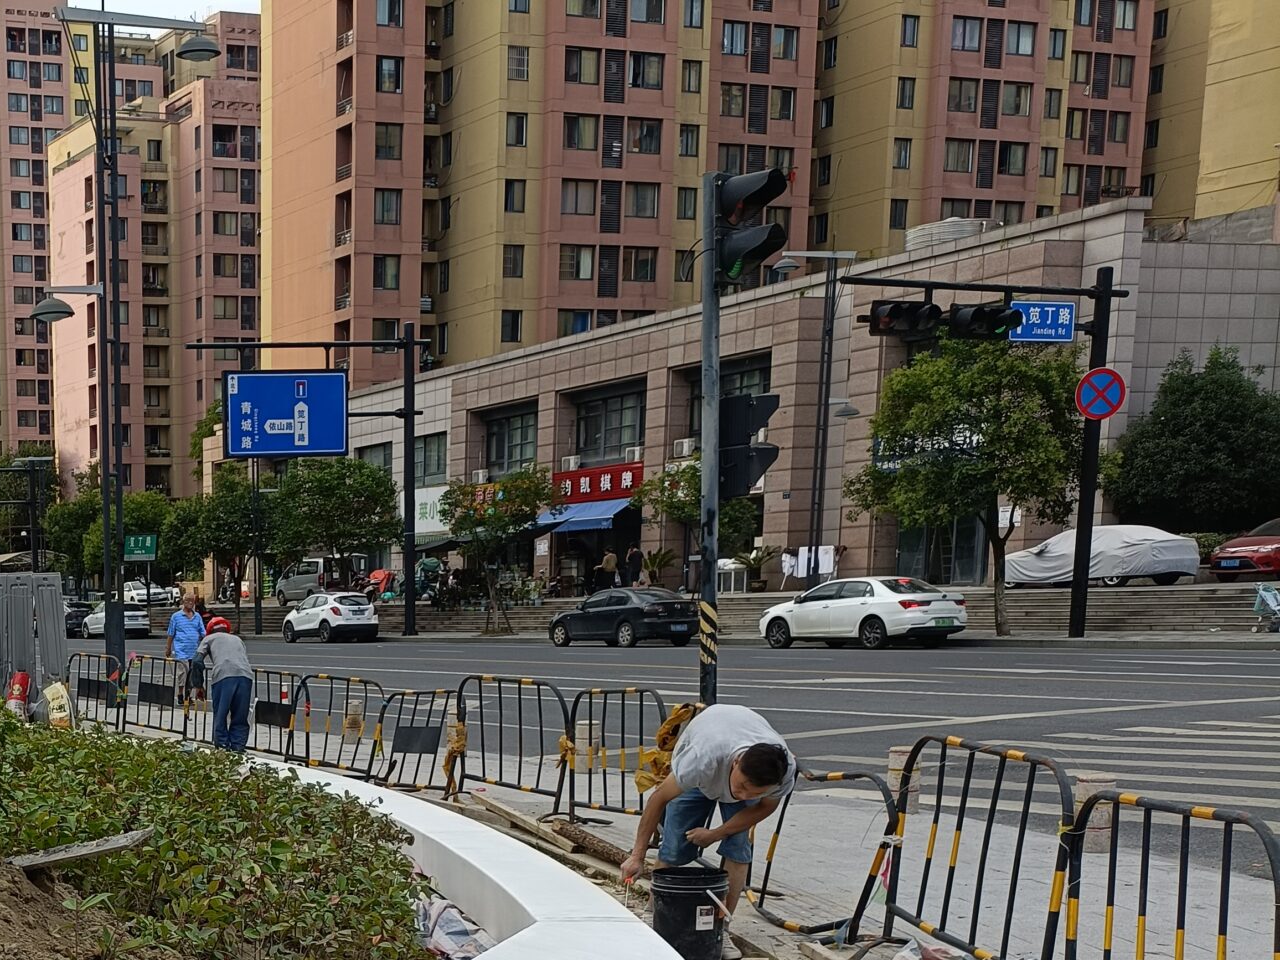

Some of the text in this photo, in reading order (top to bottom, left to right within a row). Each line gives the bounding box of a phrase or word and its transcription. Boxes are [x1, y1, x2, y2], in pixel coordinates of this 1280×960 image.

[1029, 307, 1070, 324] 笕丁路
[1032, 327, 1055, 336] Jianding
[241, 402, 252, 448] 青城路
[269, 422, 293, 431] 依山路
